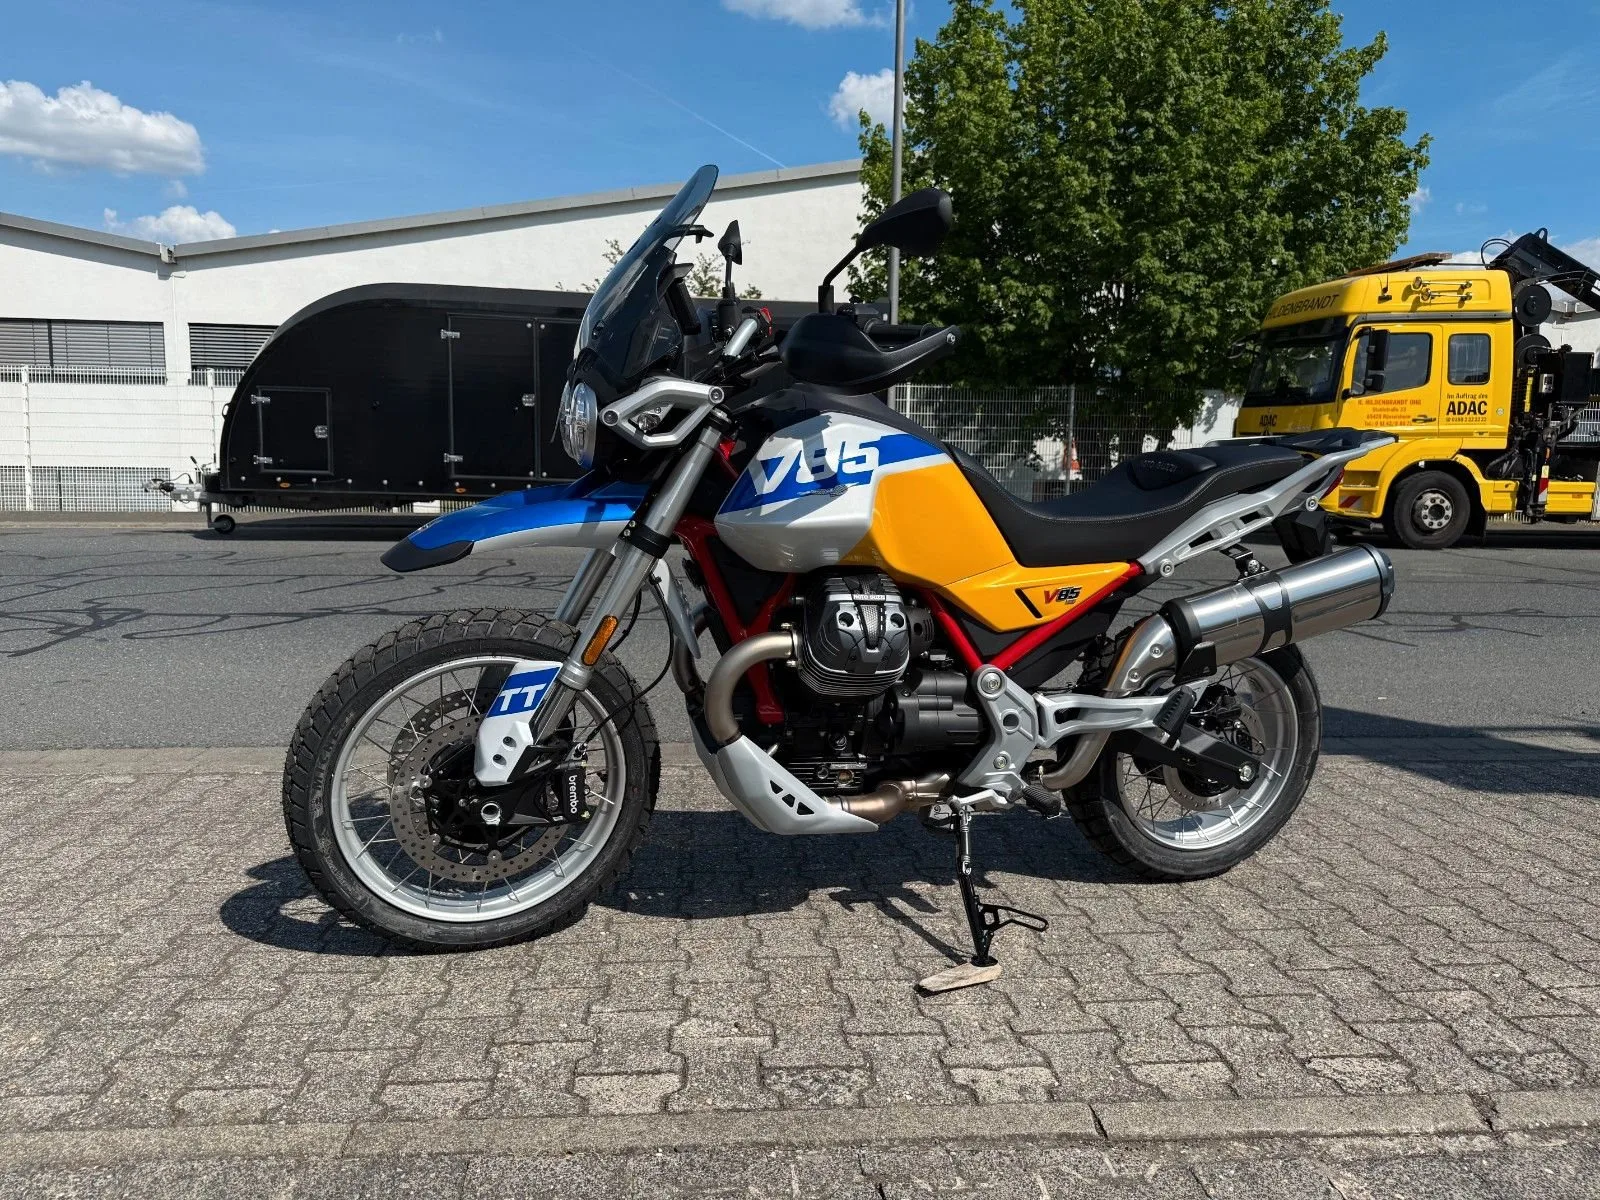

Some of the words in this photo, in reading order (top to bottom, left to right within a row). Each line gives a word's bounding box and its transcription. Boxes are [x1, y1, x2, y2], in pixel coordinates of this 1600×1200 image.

[1456, 392, 1477, 400] Auftrag
[1446, 400, 1488, 416] ADAC
[1259, 414, 1278, 427] ADAC
[749, 441, 880, 496] V85
[1044, 586, 1083, 605] V85
[499, 683, 547, 711] TT
[568, 774, 578, 814] brembo
